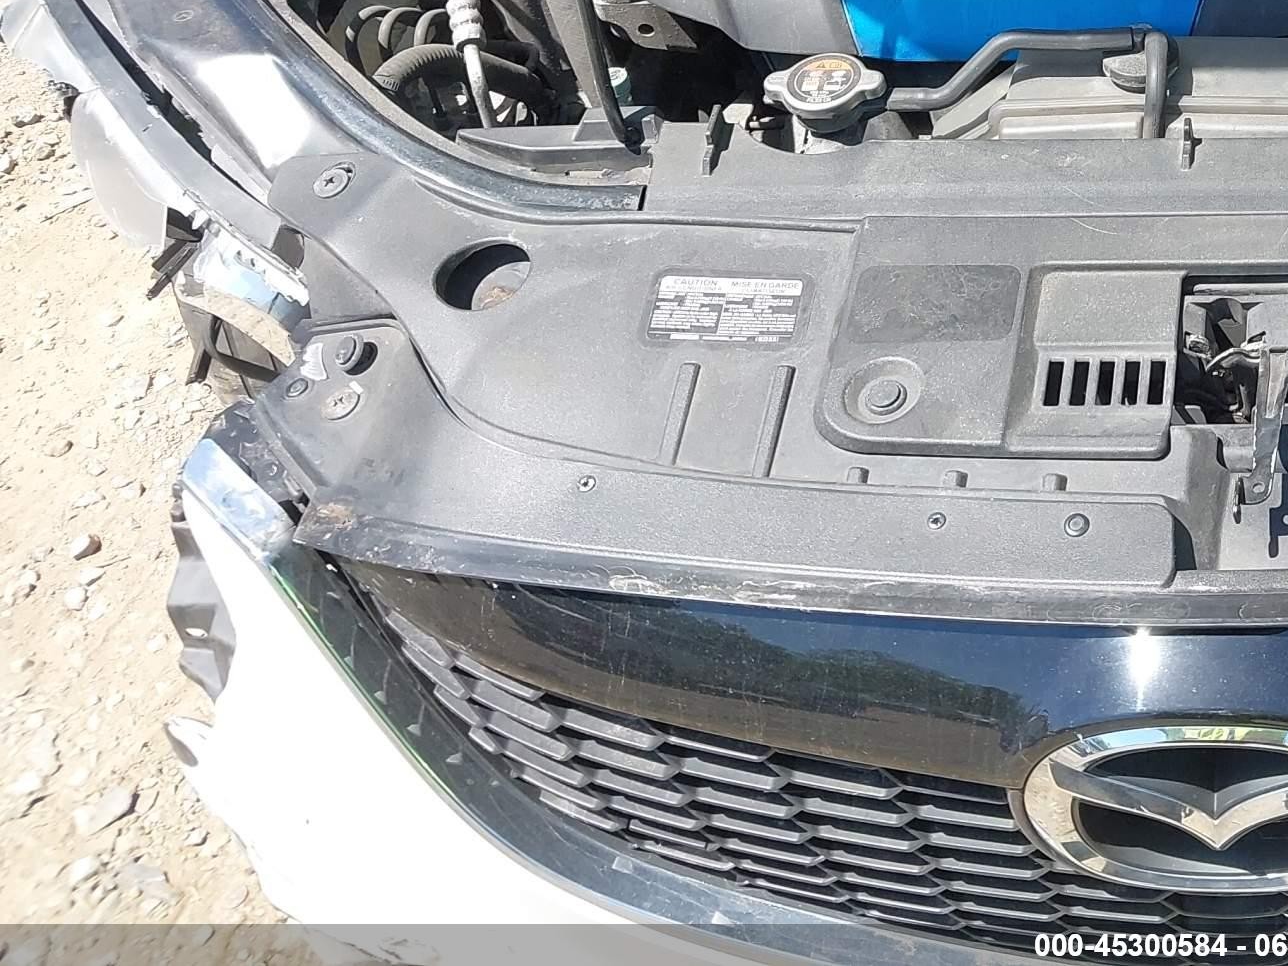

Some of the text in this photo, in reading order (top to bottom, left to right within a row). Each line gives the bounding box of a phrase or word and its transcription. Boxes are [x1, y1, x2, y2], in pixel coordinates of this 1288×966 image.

[673, 277, 718, 287] CAUTION
[731, 280, 752, 289] MISE
[768, 282, 800, 290] GARDE
